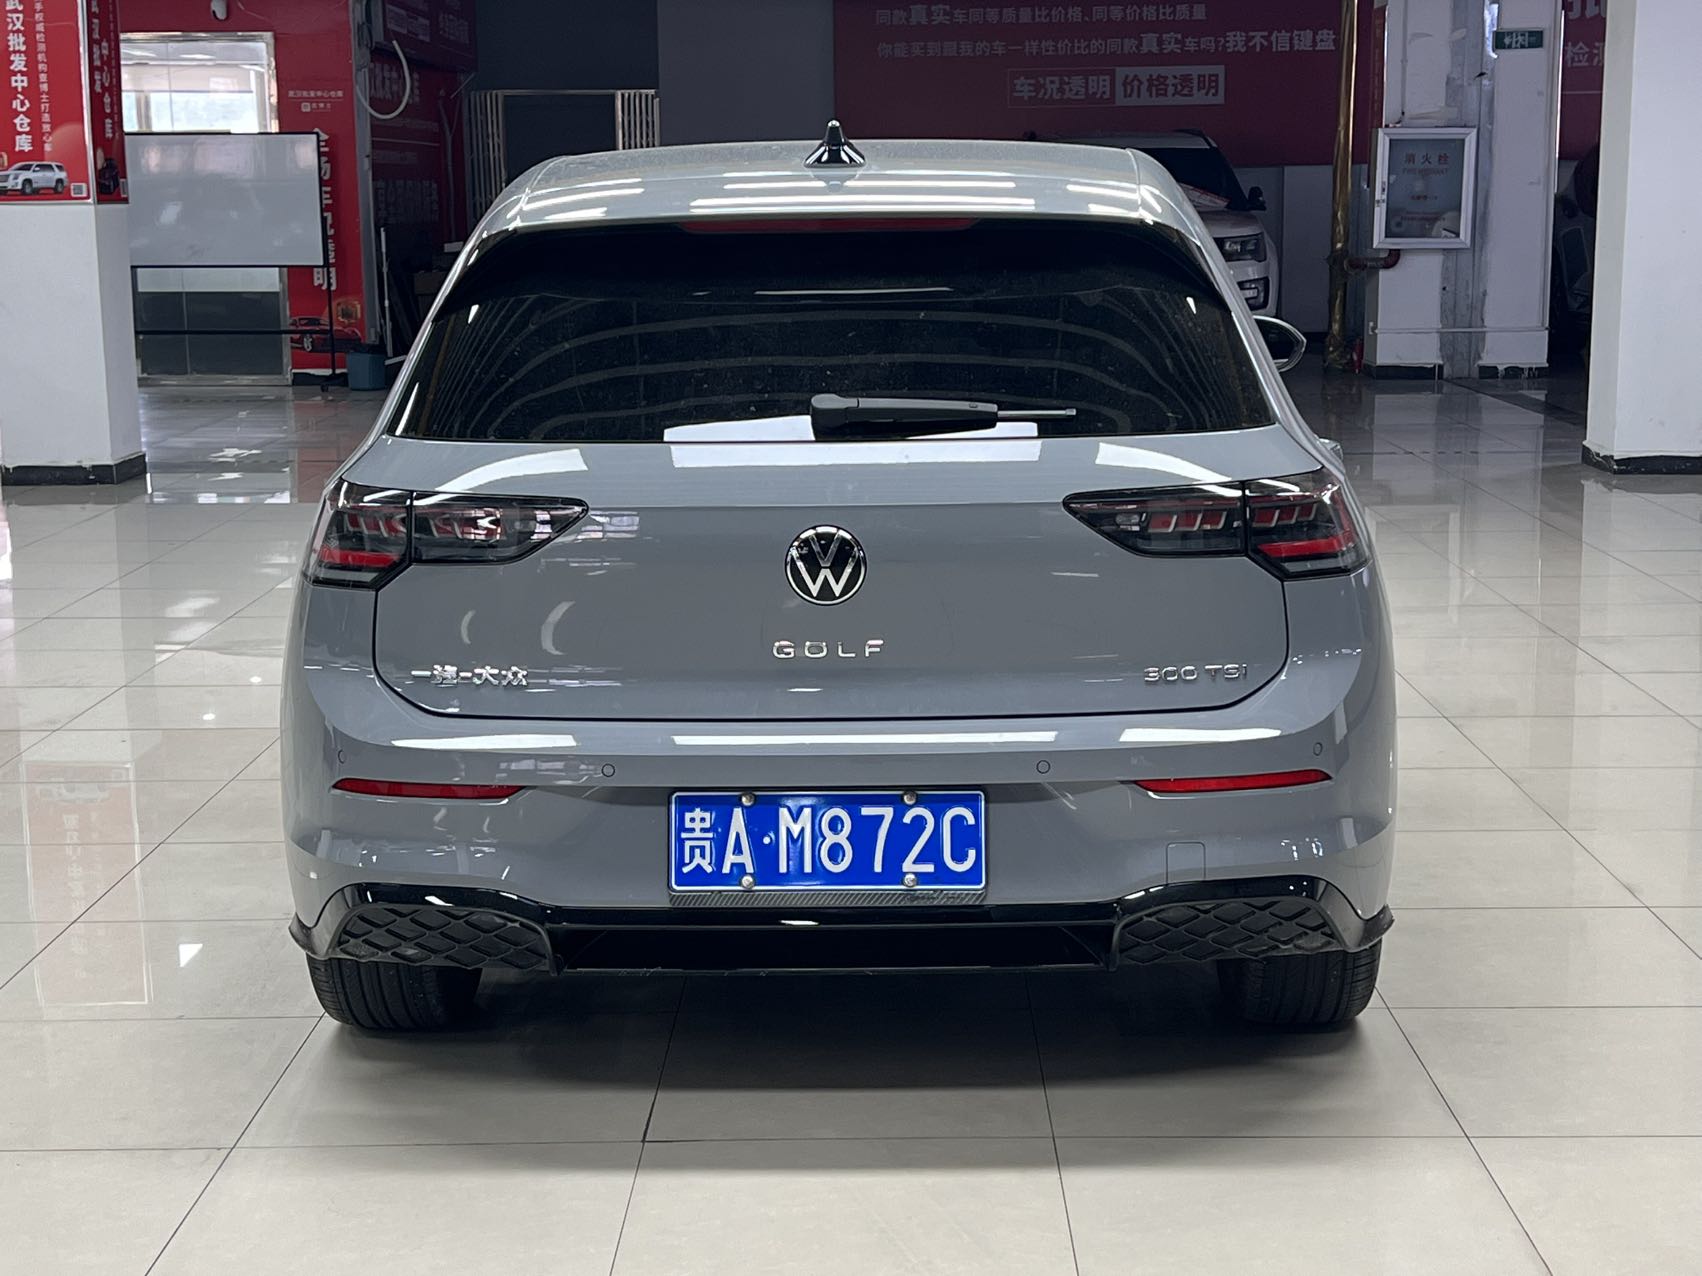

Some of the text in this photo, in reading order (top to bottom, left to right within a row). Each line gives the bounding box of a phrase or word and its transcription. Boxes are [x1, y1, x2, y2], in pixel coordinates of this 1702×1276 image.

[1012, 72, 1220, 100] 车况透明 价格透明
[1404, 152, 1449, 165] 消火栓
[772, 639, 885, 659] GOLF
[1143, 665, 1198, 682] 300
